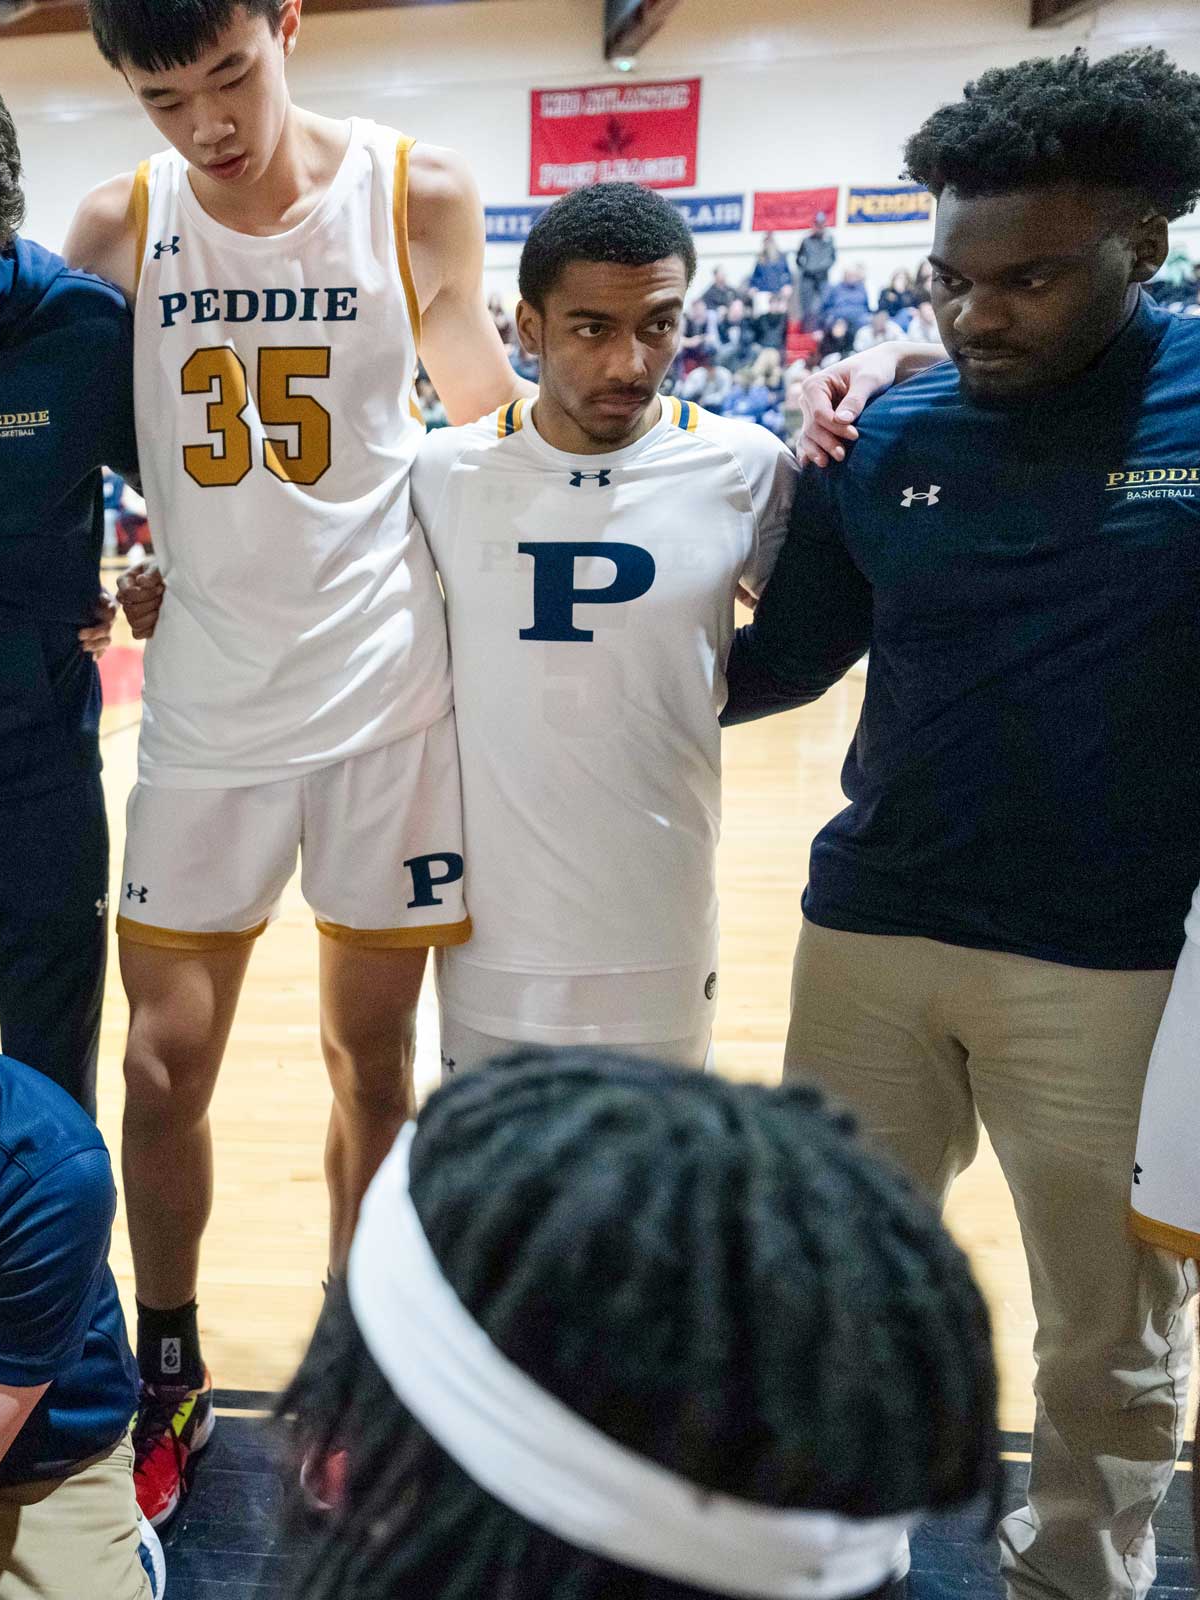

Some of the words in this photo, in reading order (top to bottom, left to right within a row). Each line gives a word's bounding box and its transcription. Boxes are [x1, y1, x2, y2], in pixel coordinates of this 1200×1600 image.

[674, 203, 741, 227] LAIR
[159, 287, 357, 328] PEDDIE
[181, 346, 331, 487] 35
[1106, 468, 1200, 486] PEDDI
[1126, 489, 1195, 500] BASKETBALL
[518, 542, 656, 642] P
[403, 852, 464, 908] P
